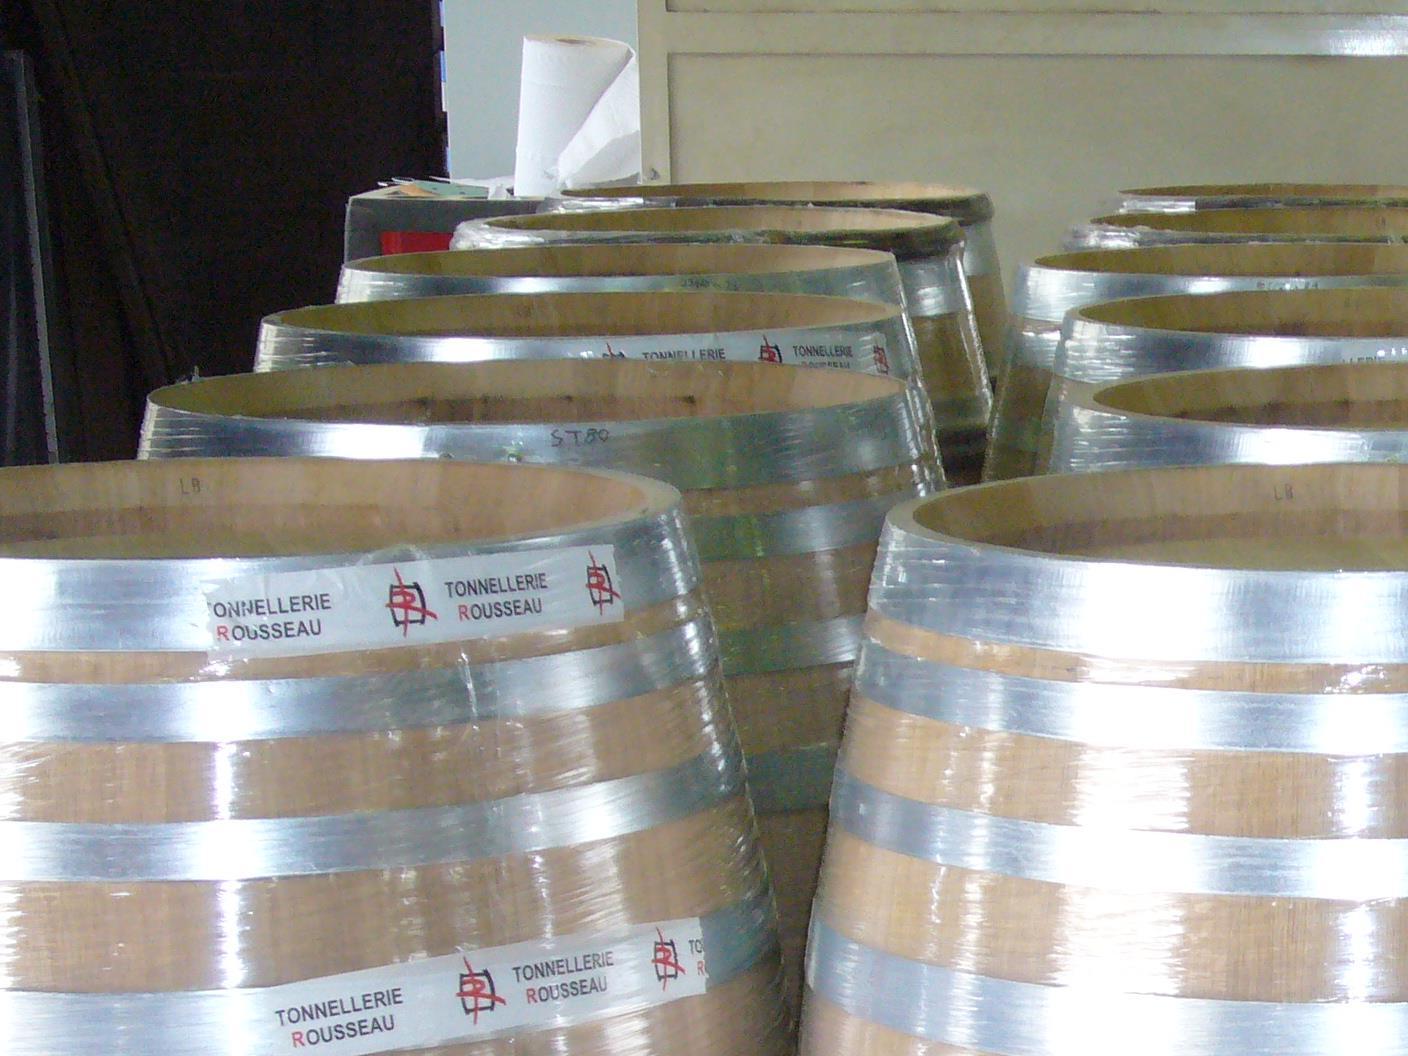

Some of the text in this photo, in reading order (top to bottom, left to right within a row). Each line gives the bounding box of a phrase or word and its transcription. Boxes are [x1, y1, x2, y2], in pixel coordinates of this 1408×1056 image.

[444, 573, 548, 598] TONNELLERIE
[207, 592, 332, 619] ONNELLERIE
[458, 598, 543, 622] ROUSSEAU
[216, 618, 322, 641] ROUSSEAU
[512, 951, 615, 984] TONNELLERIE
[526, 976, 609, 1005] ROUSSEAU
[274, 987, 404, 1028] TONNELLERIE
[291, 1013, 396, 1049] ROUSSEAU
